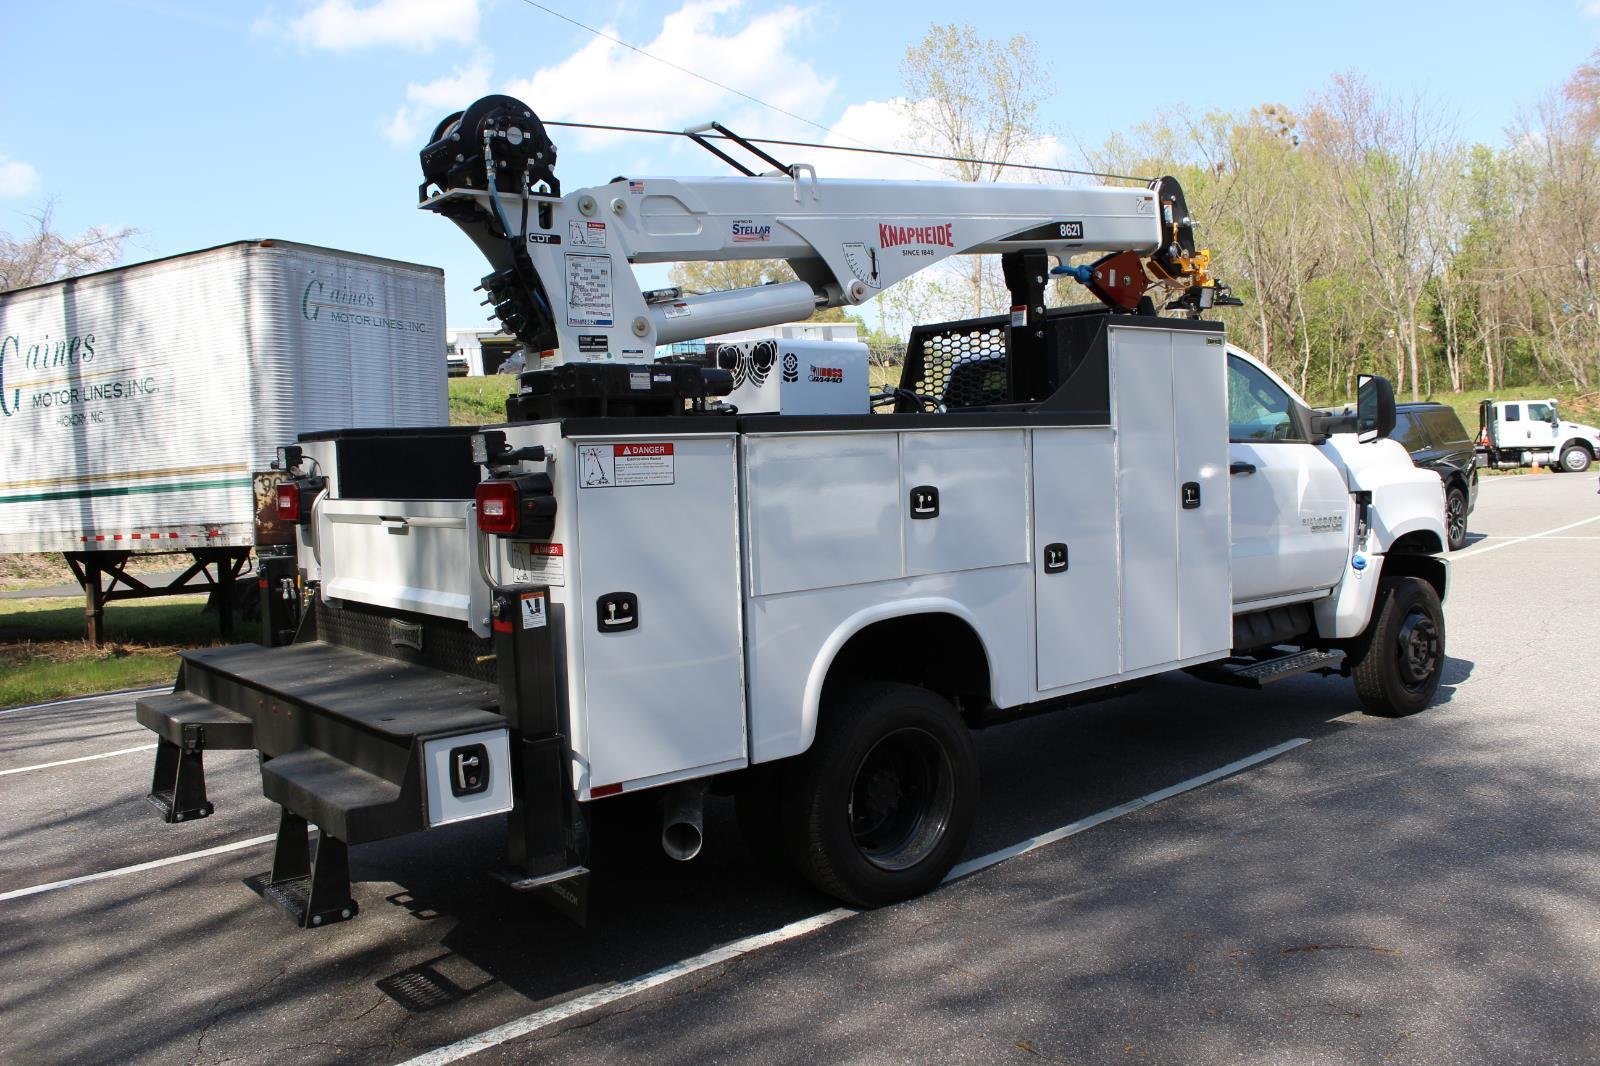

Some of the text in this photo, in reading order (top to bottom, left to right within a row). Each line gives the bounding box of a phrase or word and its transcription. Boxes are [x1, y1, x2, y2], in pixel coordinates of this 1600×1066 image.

[732, 223, 770, 235] STELLAR
[878, 223, 956, 249] KNAPHEIDE
[1059, 223, 1081, 237] 8621
[529, 233, 551, 243] CDT
[331, 311, 370, 326] MOTOR
[32, 388, 80, 409] MOTOR
[632, 446, 665, 454] DANGER
